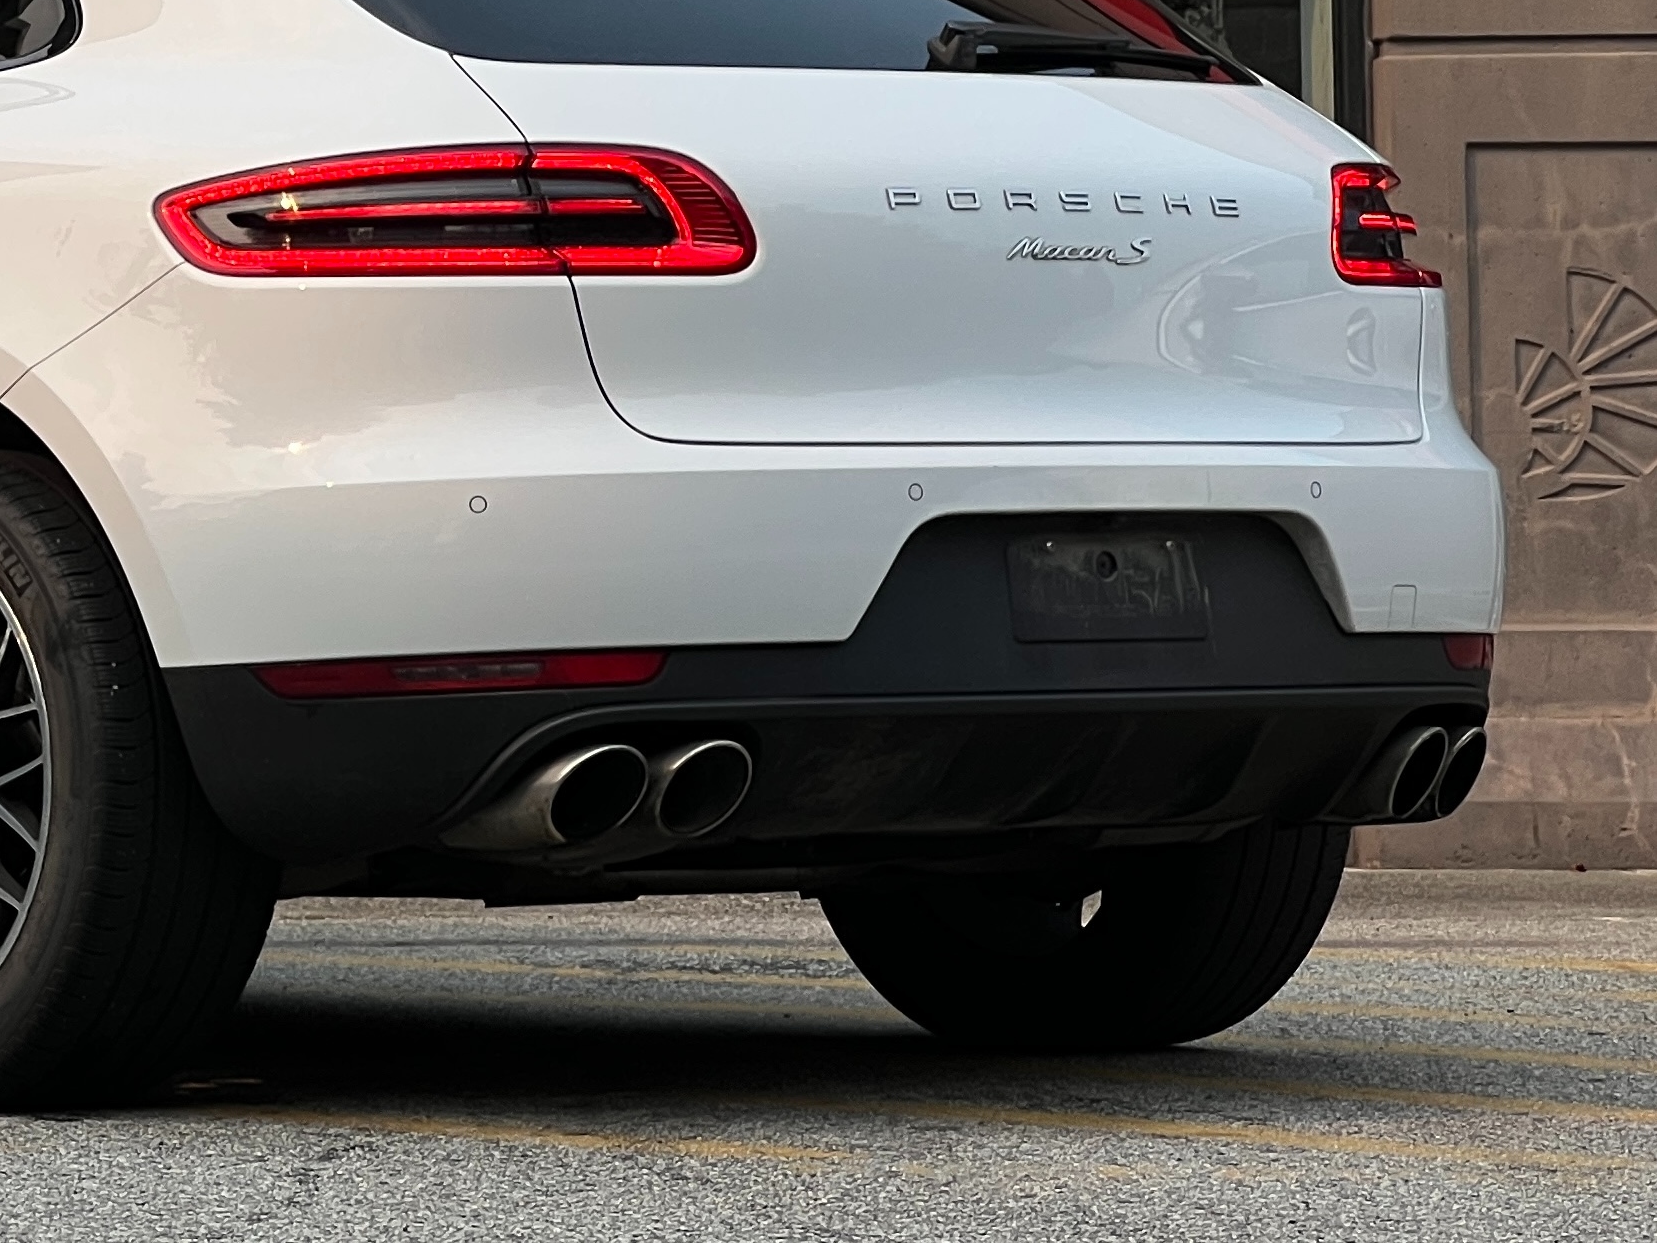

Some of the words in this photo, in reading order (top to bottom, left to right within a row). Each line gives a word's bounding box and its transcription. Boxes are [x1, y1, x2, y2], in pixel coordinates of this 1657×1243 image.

[885, 187, 1240, 218] PORSCHE
[1007, 236, 1117, 261] Macan
[1115, 237, 1153, 265] S
